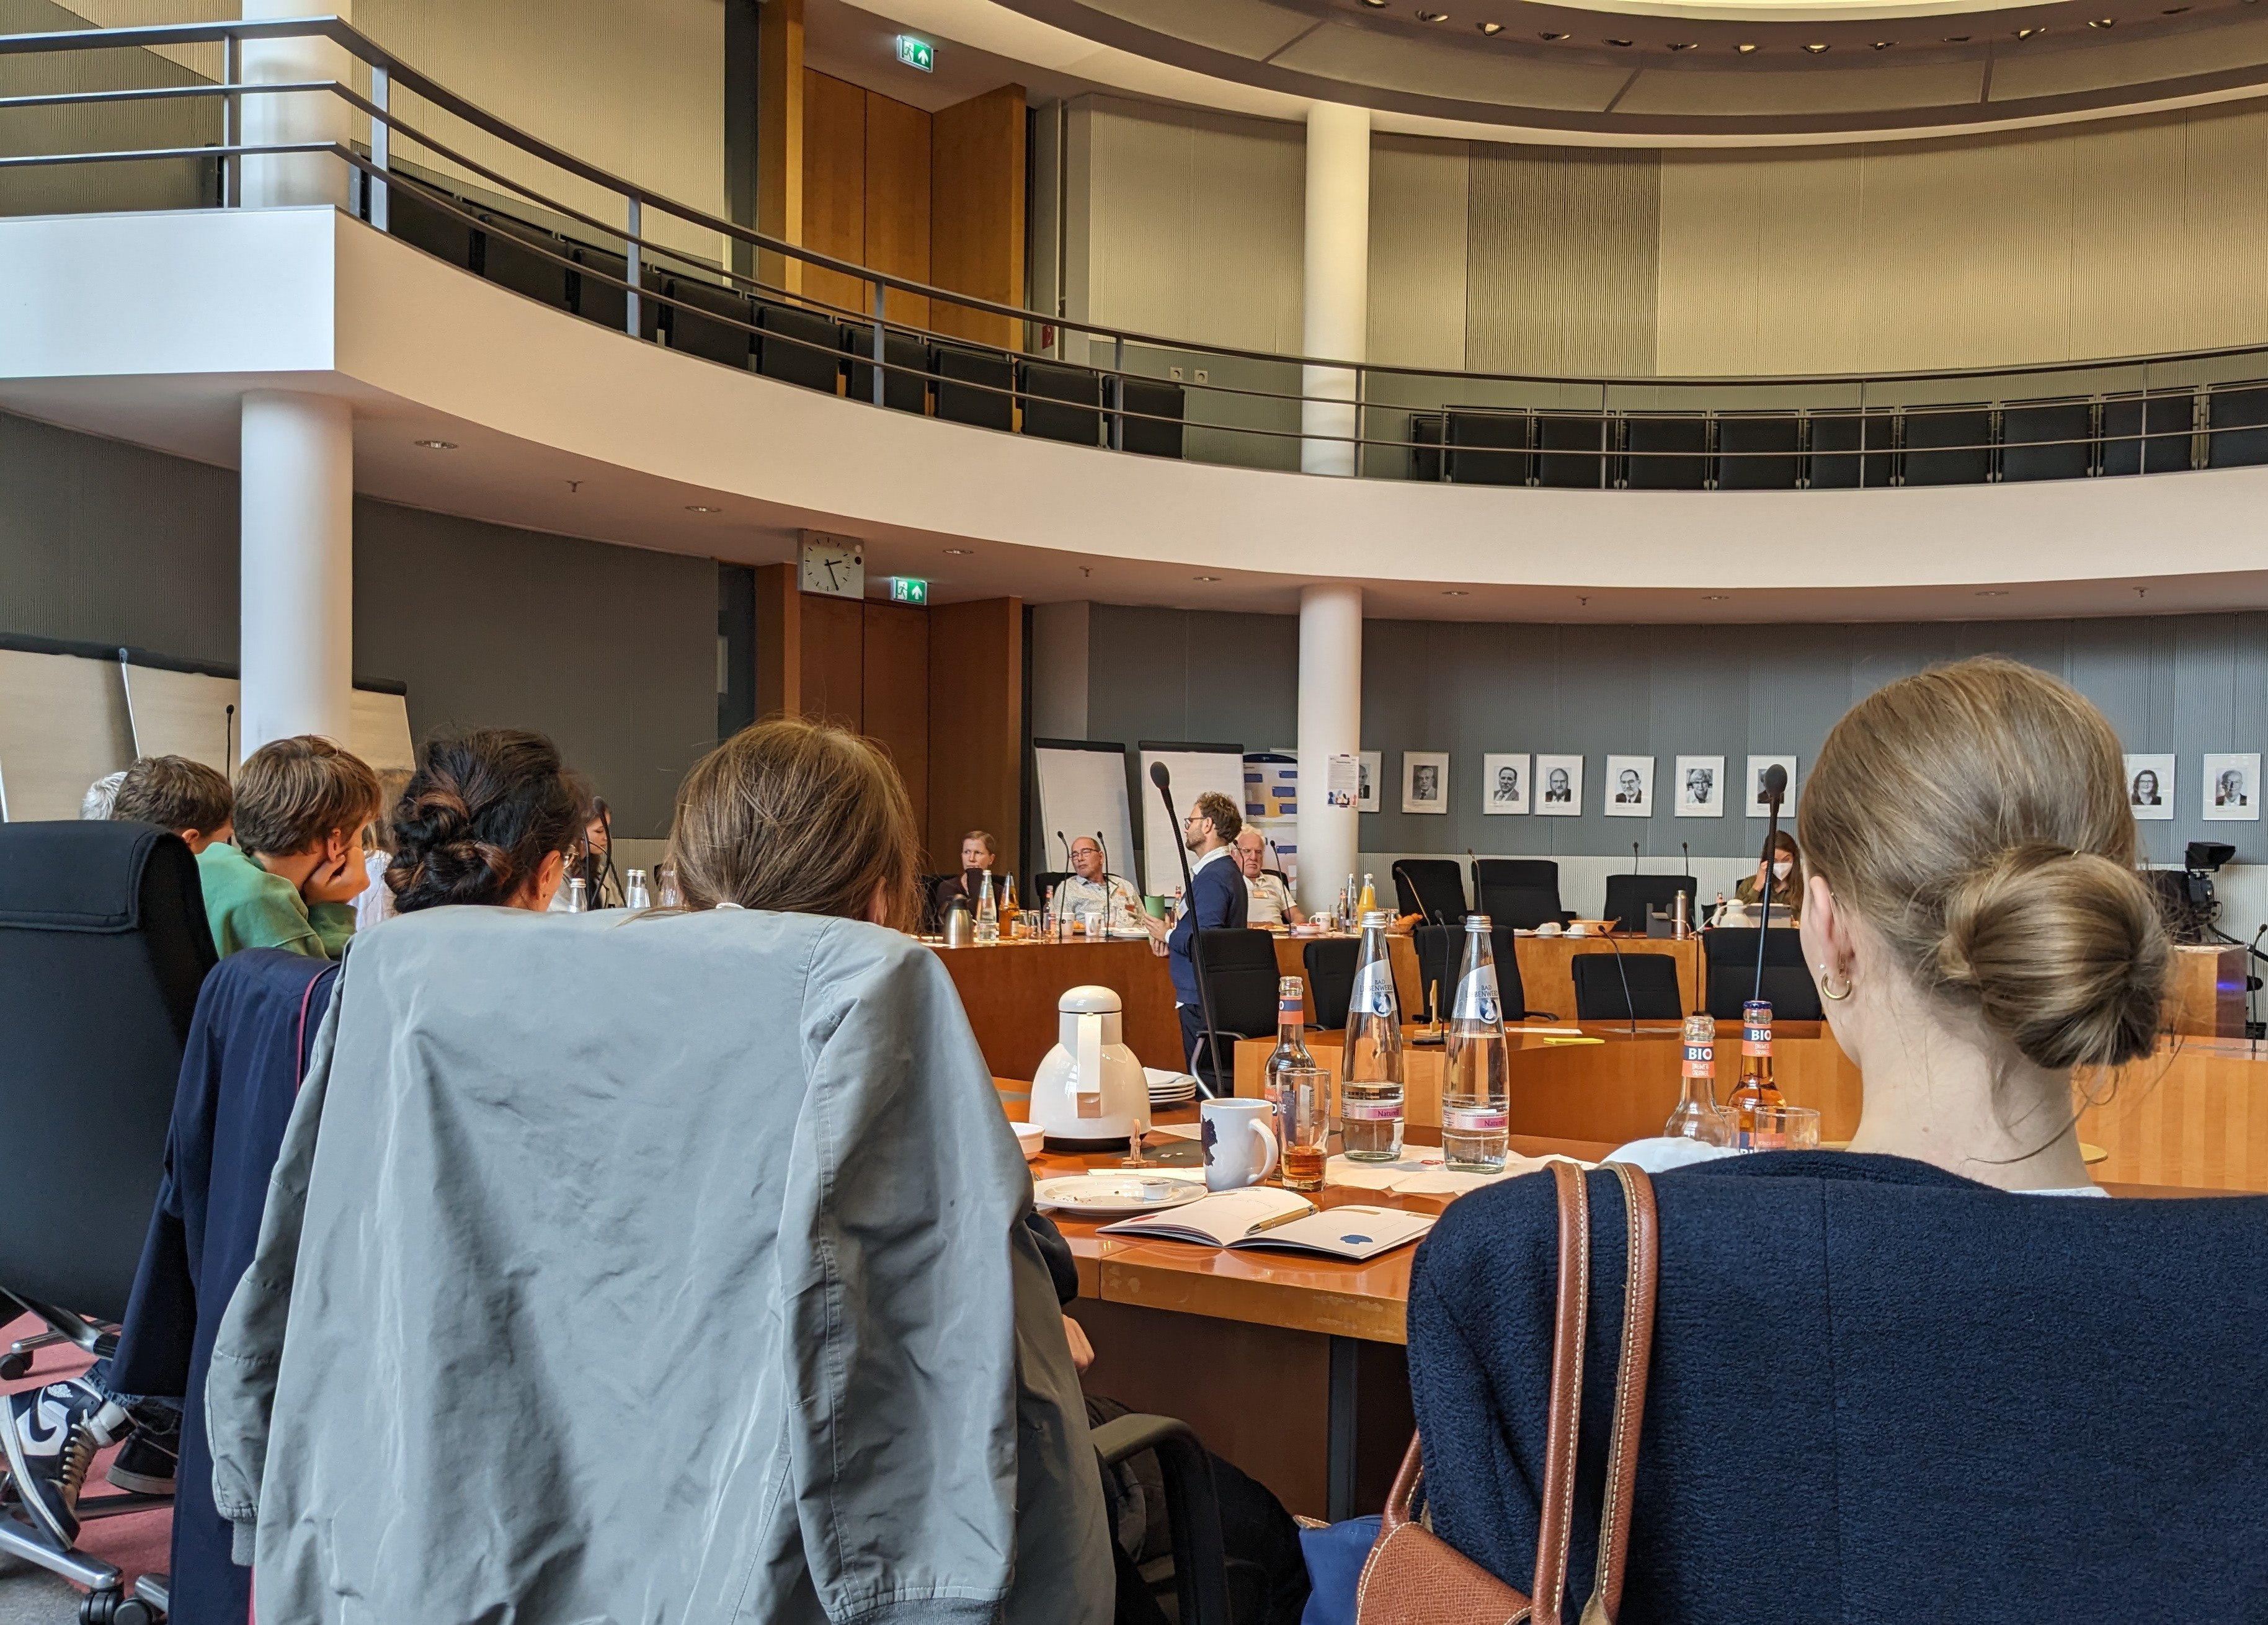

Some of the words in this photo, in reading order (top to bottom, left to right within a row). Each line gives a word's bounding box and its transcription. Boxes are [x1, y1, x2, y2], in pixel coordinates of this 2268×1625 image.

[1751, 1030, 1772, 1041] BIO
[1688, 1048, 1712, 1060] BIO
[1378, 1109, 1400, 1117] Naturell
[1484, 1118, 1505, 1127] Naturell
